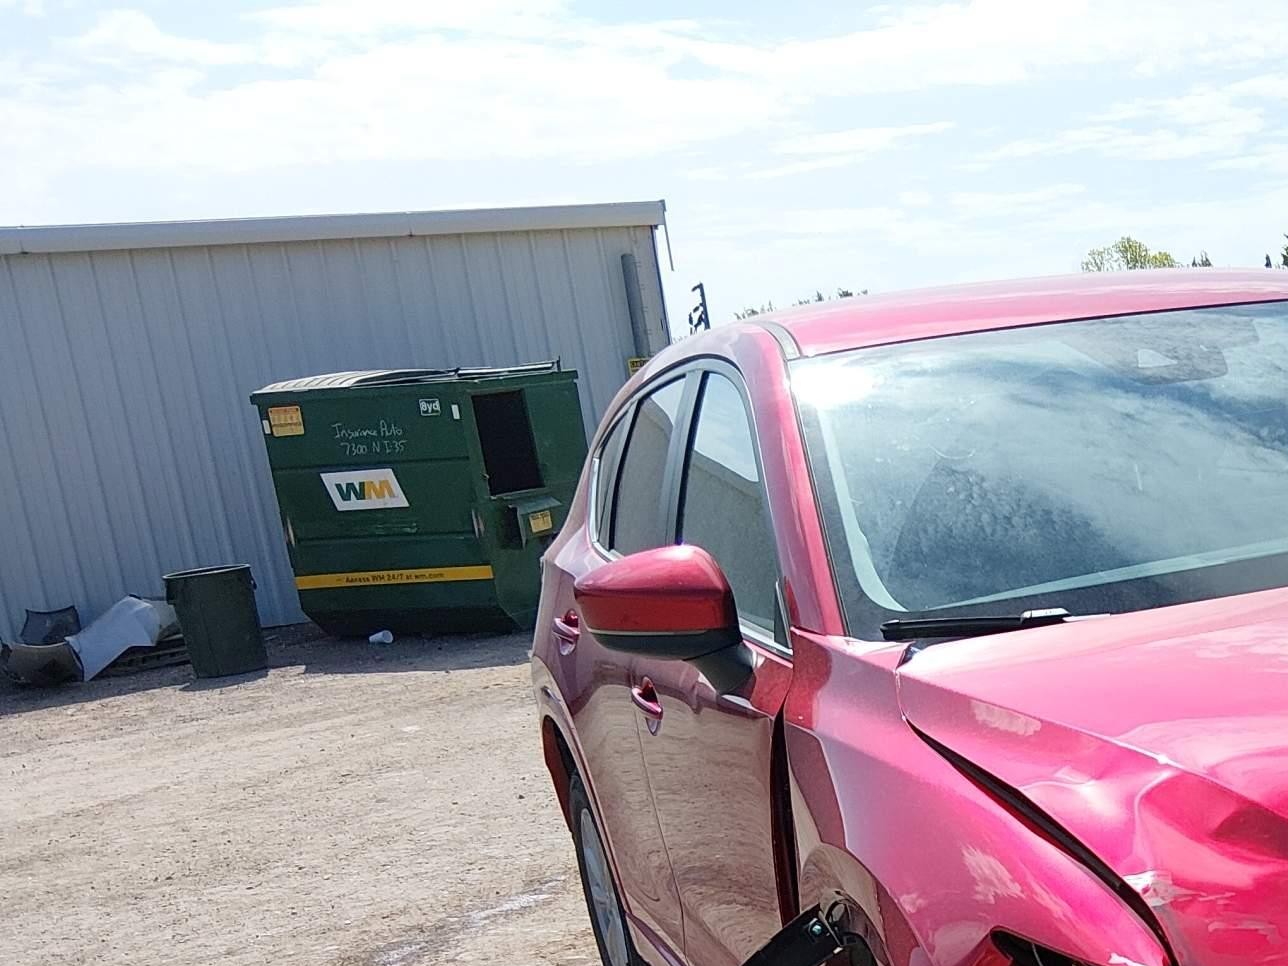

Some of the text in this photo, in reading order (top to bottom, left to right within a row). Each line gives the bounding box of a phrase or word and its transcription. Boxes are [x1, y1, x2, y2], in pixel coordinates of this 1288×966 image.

[420, 400, 439, 413] 8yd
[380, 420, 402, 436] Auto
[340, 442, 367, 456] 7300
[373, 440, 381, 453] N
[335, 479, 396, 501] WM
[372, 574, 384, 582] WM
[386, 573, 403, 581] 24/7
[414, 572, 445, 580] wm.com
